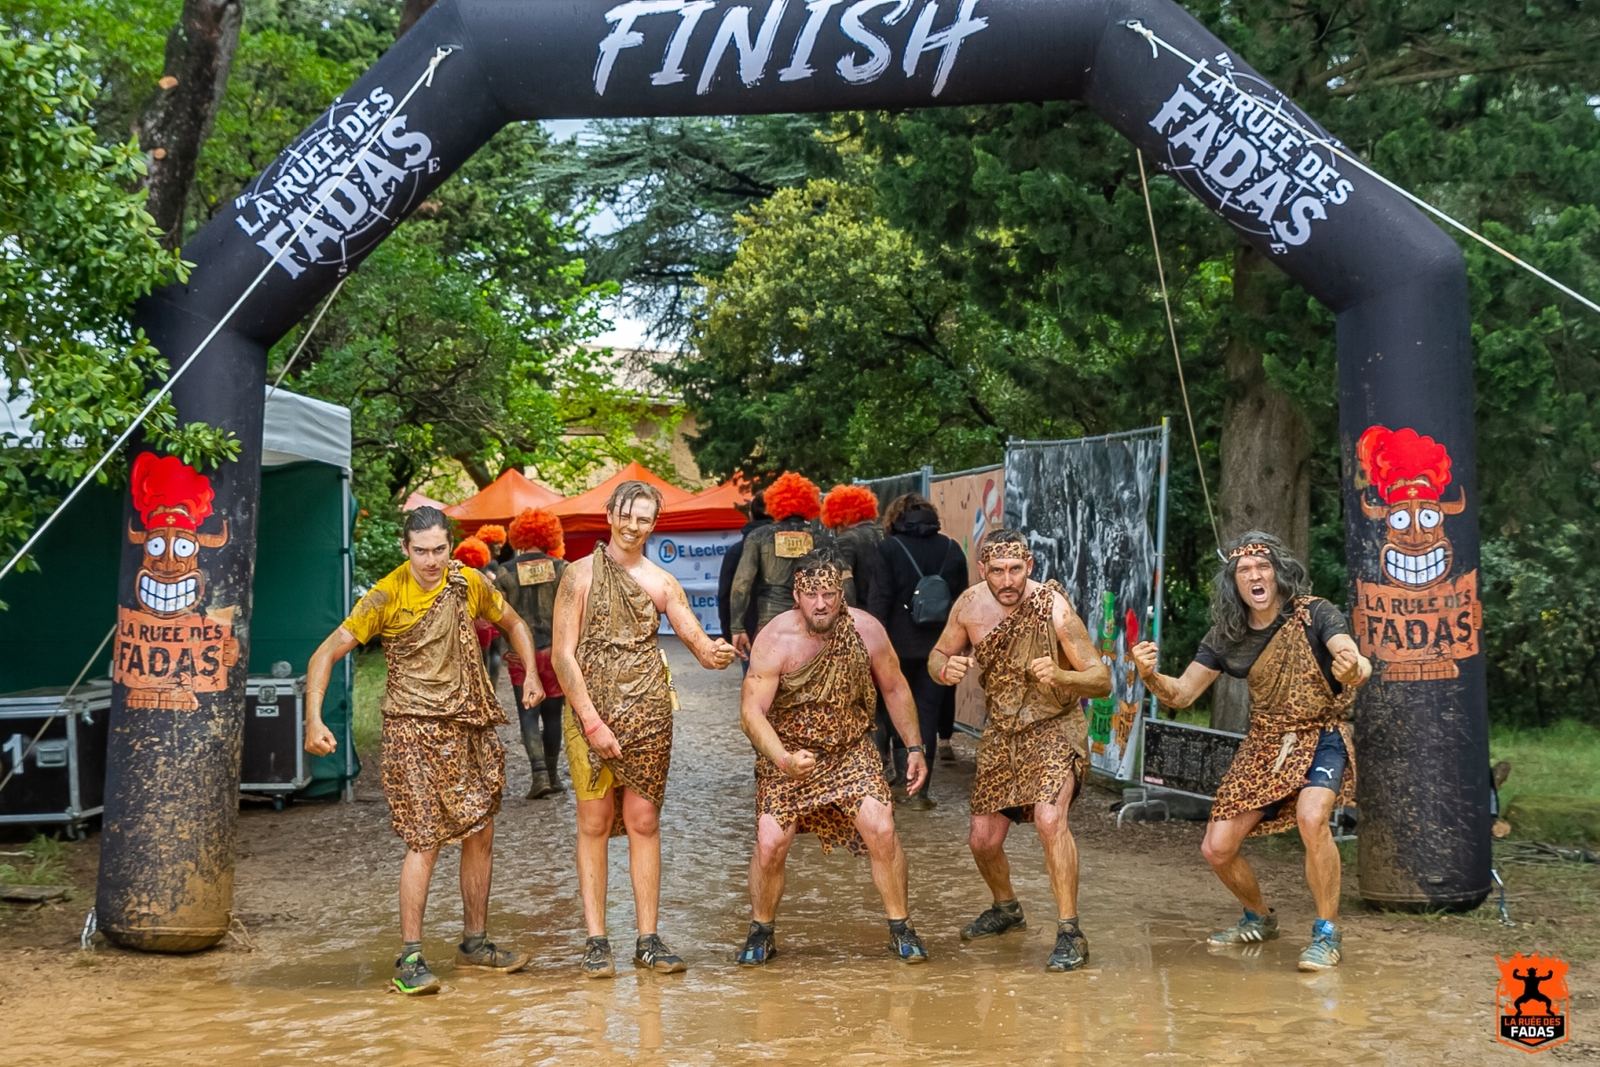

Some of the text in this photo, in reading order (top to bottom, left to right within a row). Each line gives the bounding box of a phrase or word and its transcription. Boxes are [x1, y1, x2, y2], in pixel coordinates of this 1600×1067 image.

[593, 0, 990, 97] FINISH
[236, 194, 281, 236] LA
[339, 87, 395, 141] DES
[1148, 84, 1328, 246] FADAS
[1188, 58, 1233, 102] LA
[1295, 151, 1355, 205] DES
[256, 115, 432, 279] FADAS
[120, 619, 136, 637] LA
[1365, 594, 1386, 613] LA
[1366, 611, 1472, 650] FADAS
[118, 642, 221, 679] FADAS
[2, 733, 24, 774] 1
